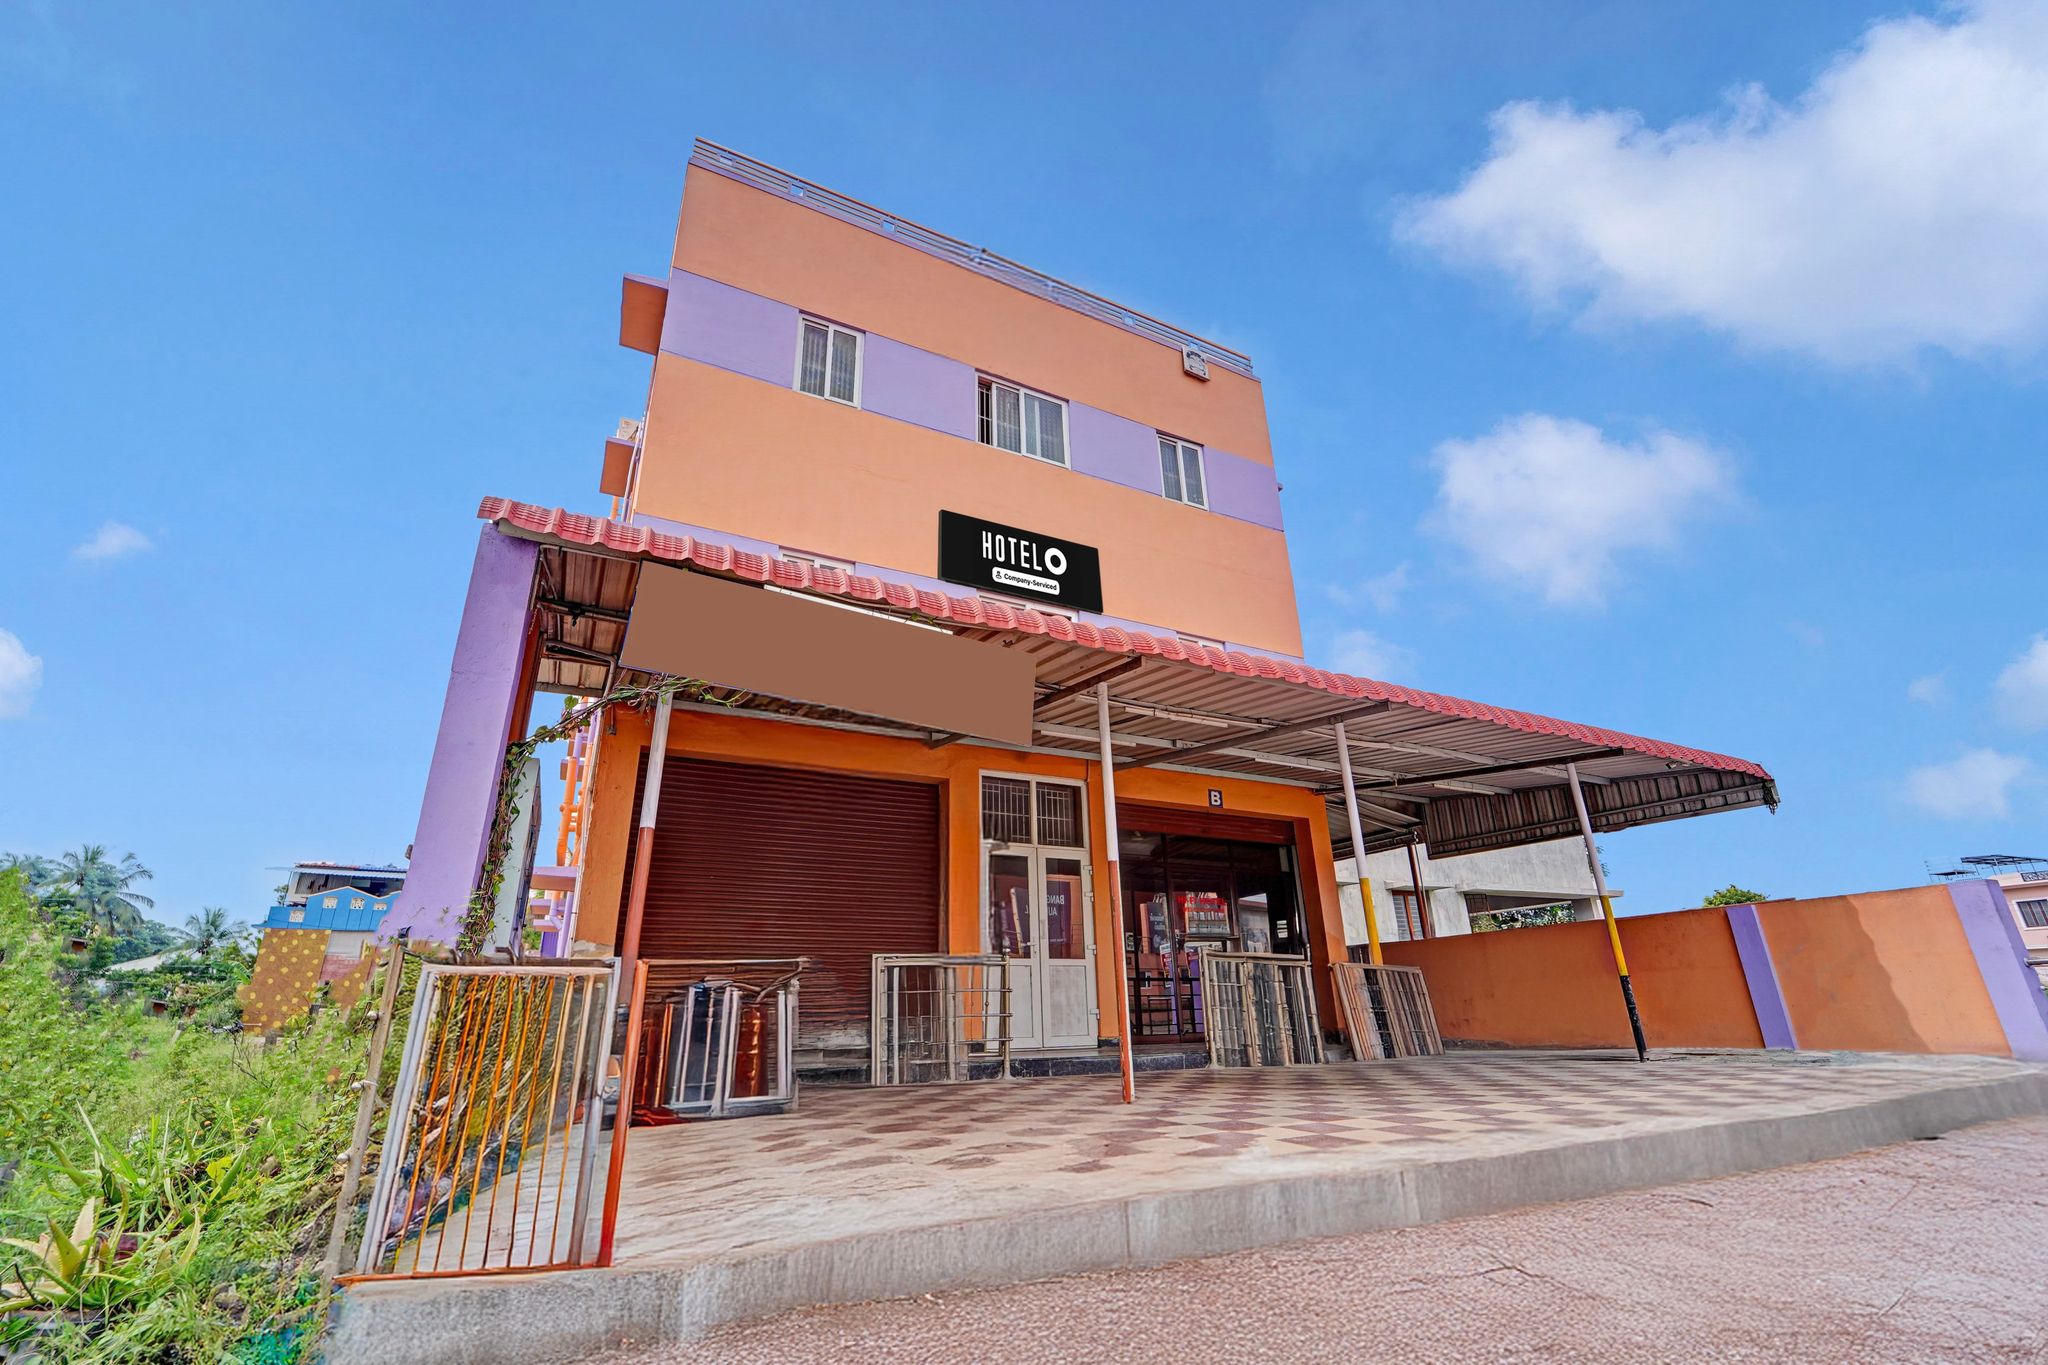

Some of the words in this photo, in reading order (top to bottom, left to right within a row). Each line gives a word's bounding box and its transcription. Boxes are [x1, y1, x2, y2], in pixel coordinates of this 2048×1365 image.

[982, 530, 1043, 571] HOTEL
[1003, 573, 1058, 591] Company-Serviced
[1210, 791, 1222, 806] B
